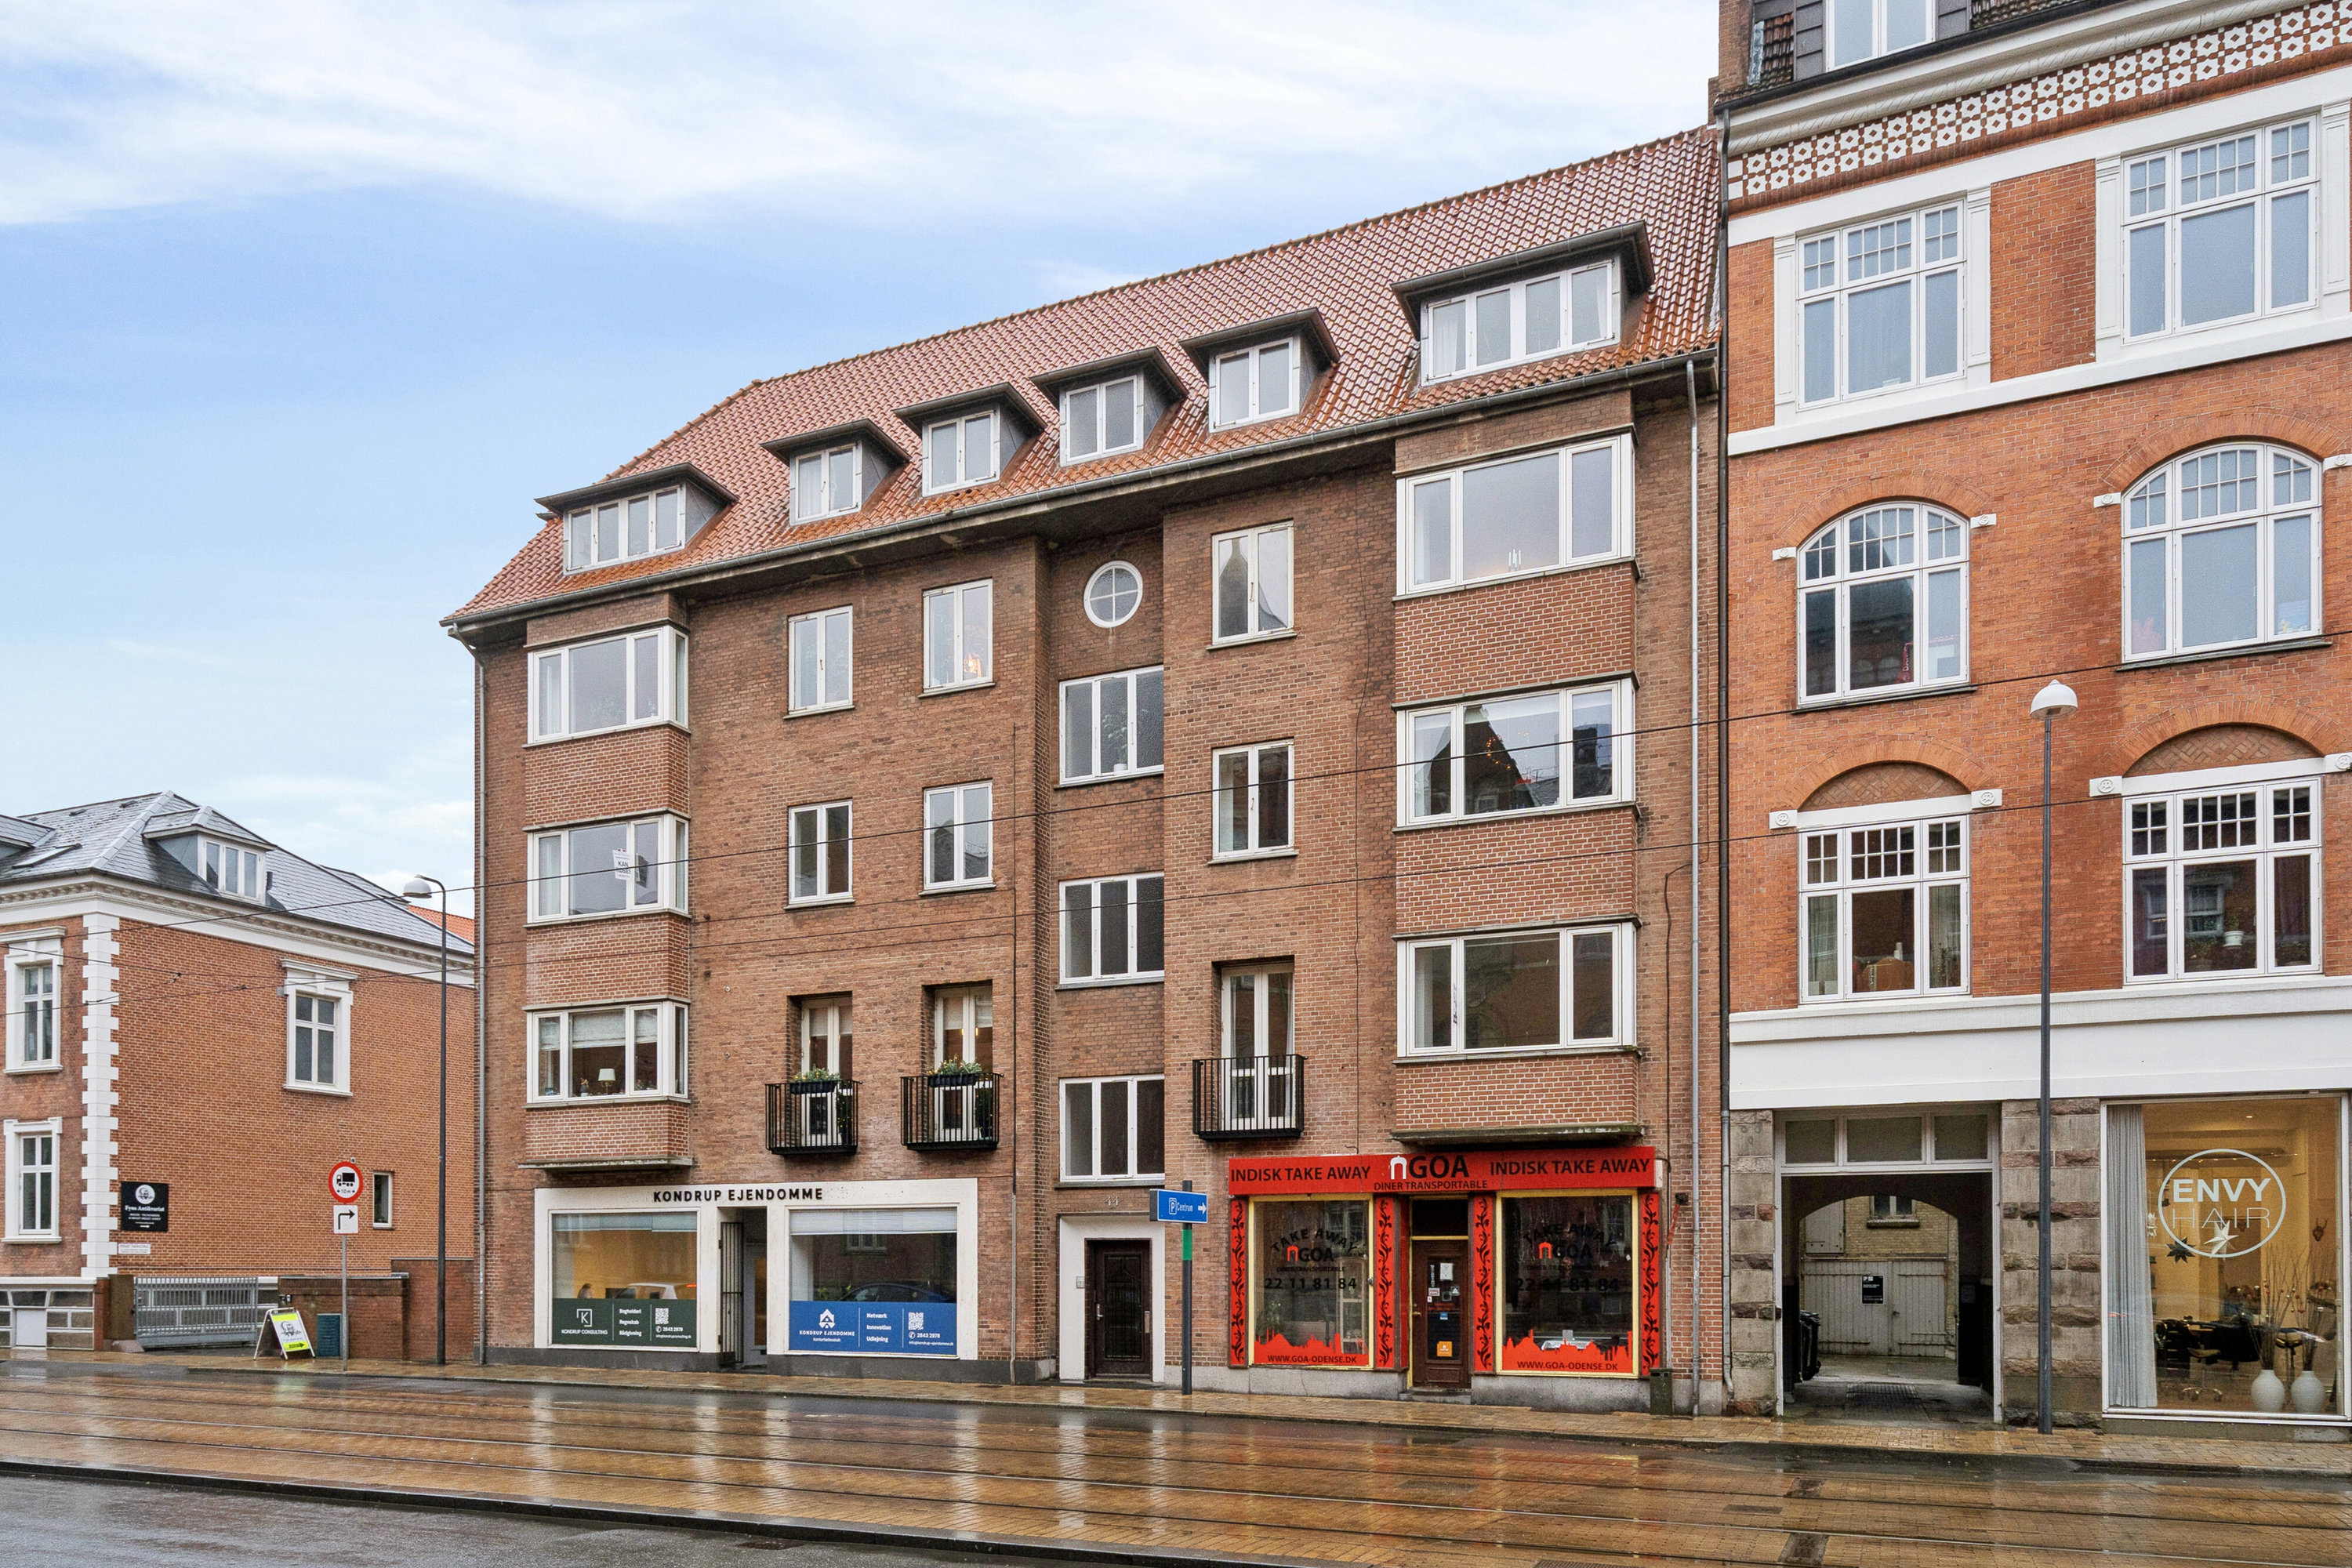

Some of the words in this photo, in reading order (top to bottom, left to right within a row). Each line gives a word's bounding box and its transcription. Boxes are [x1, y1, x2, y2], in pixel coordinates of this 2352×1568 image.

[1231, 1168, 1281, 1182] INDISK
[1284, 1167, 1323, 1181] TAKE
[1327, 1166, 1371, 1180] AWAY
[1408, 1155, 1470, 1179] GOA
[1490, 1160, 1548, 1176] INDISK
[1552, 1160, 1595, 1174] TAKE
[1599, 1158, 1650, 1174] AWAY
[1374, 1181, 1403, 1191] DINER
[1405, 1180, 1487, 1190] TRANSPORTABLE
[2173, 1178, 2271, 1203] ENVY
[653, 1189, 722, 1203] KONDRUP
[728, 1188, 822, 1201] EJENDOMME
[1177, 1202, 1193, 1212] Centrum
[2172, 1207, 2270, 1229] HAIR
[1271, 1229, 1308, 1253] TAKE
[1315, 1229, 1357, 1253] AWAY
[1298, 1247, 1334, 1262] GOA
[1264, 1278, 1283, 1289] 22
[1290, 1278, 1305, 1289] 11
[1313, 1278, 1330, 1290] 81
[1338, 1277, 1357, 1290] 84
[1267, 1355, 1357, 1363] WWW.GOA-ODENSE.DK
[1517, 1360, 1618, 1370] WWW.GOA-ODENSE.DK
